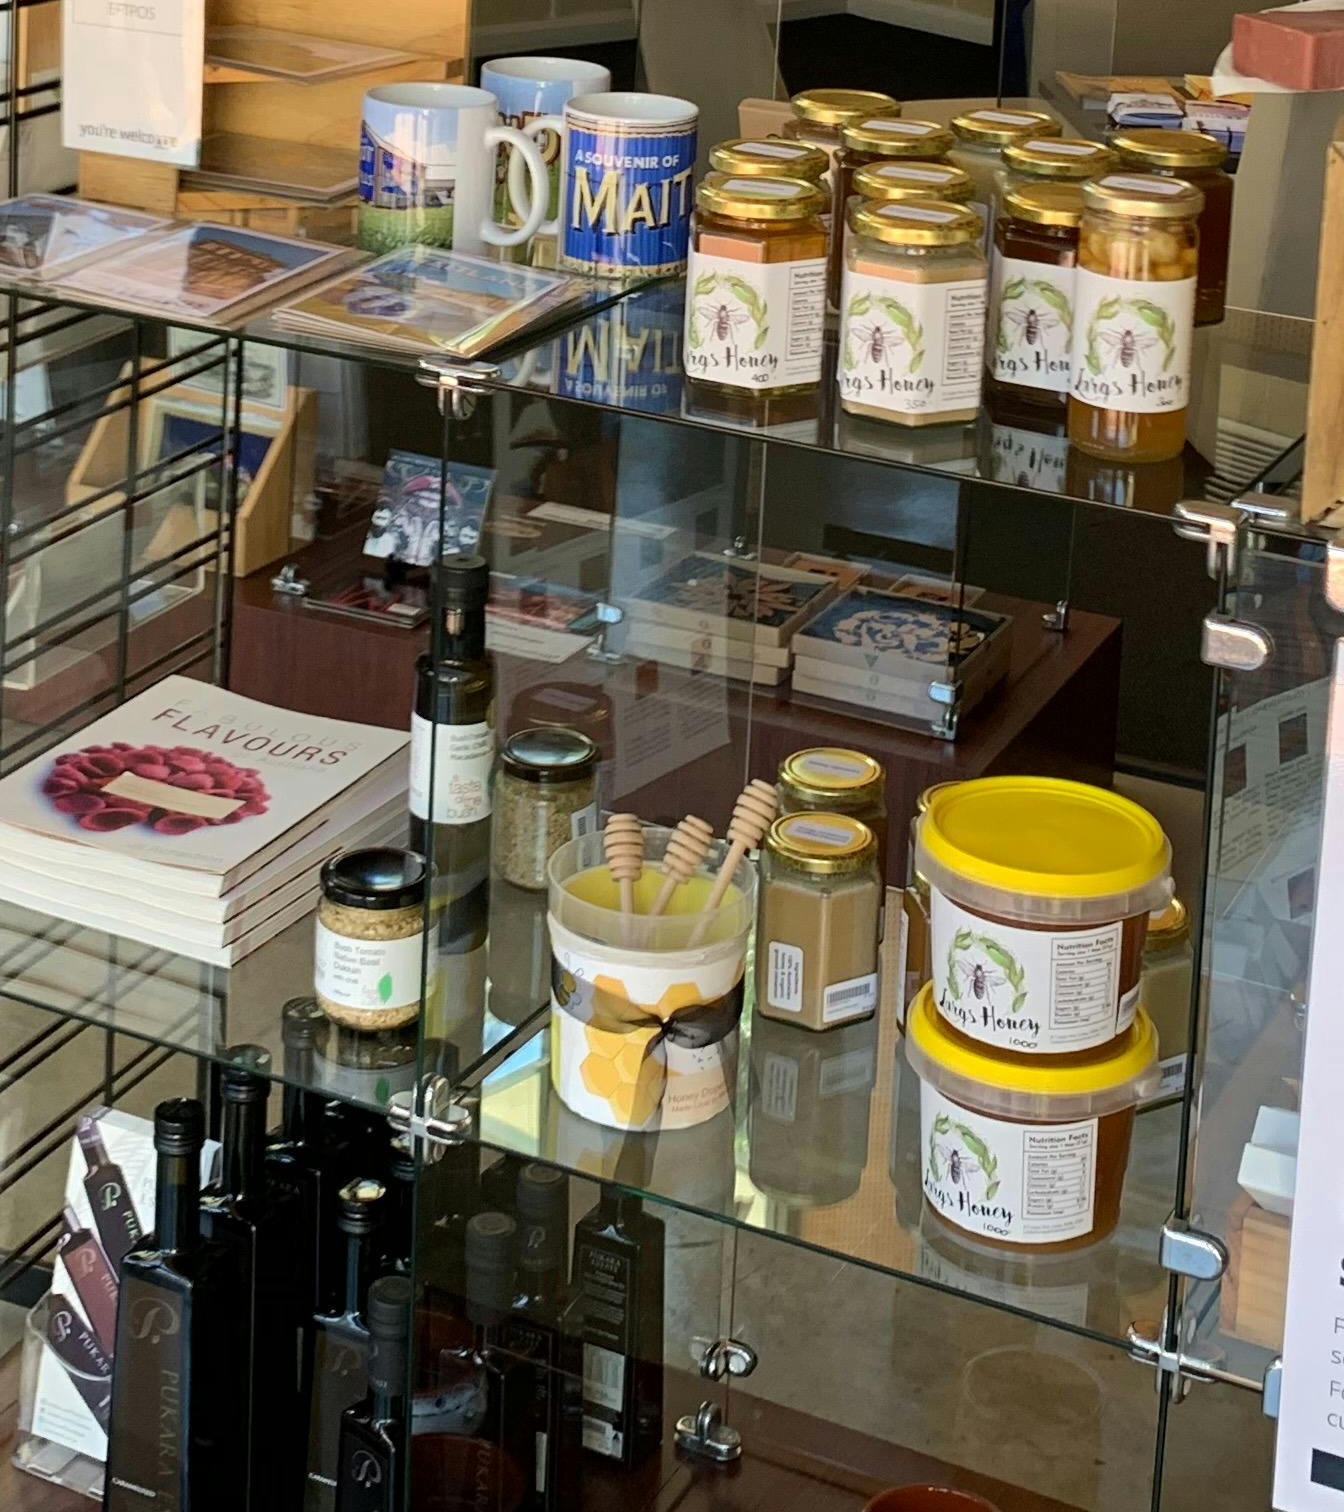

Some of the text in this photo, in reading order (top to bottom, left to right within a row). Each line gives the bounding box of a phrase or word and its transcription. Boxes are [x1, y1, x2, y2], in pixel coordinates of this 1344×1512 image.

[108, 1, 156, 20] EFTPOS
[80, 122, 117, 140] you're
[575, 150, 679, 169] A SOUVENIR OF
[571, 166, 692, 236] MAIT
[725, 348, 778, 372] Honey
[879, 370, 935, 395] Honey
[1130, 366, 1183, 398] Honey
[152, 708, 348, 766] FLAVOURS
[1056, 935, 1115, 952] Nutrition Facts
[981, 1004, 1042, 1035] Honey
[1029, 1132, 1089, 1144] Nutrition Facts
[958, 1191, 1014, 1224] Honey
[158, 1367, 180, 1478] PUKARA
